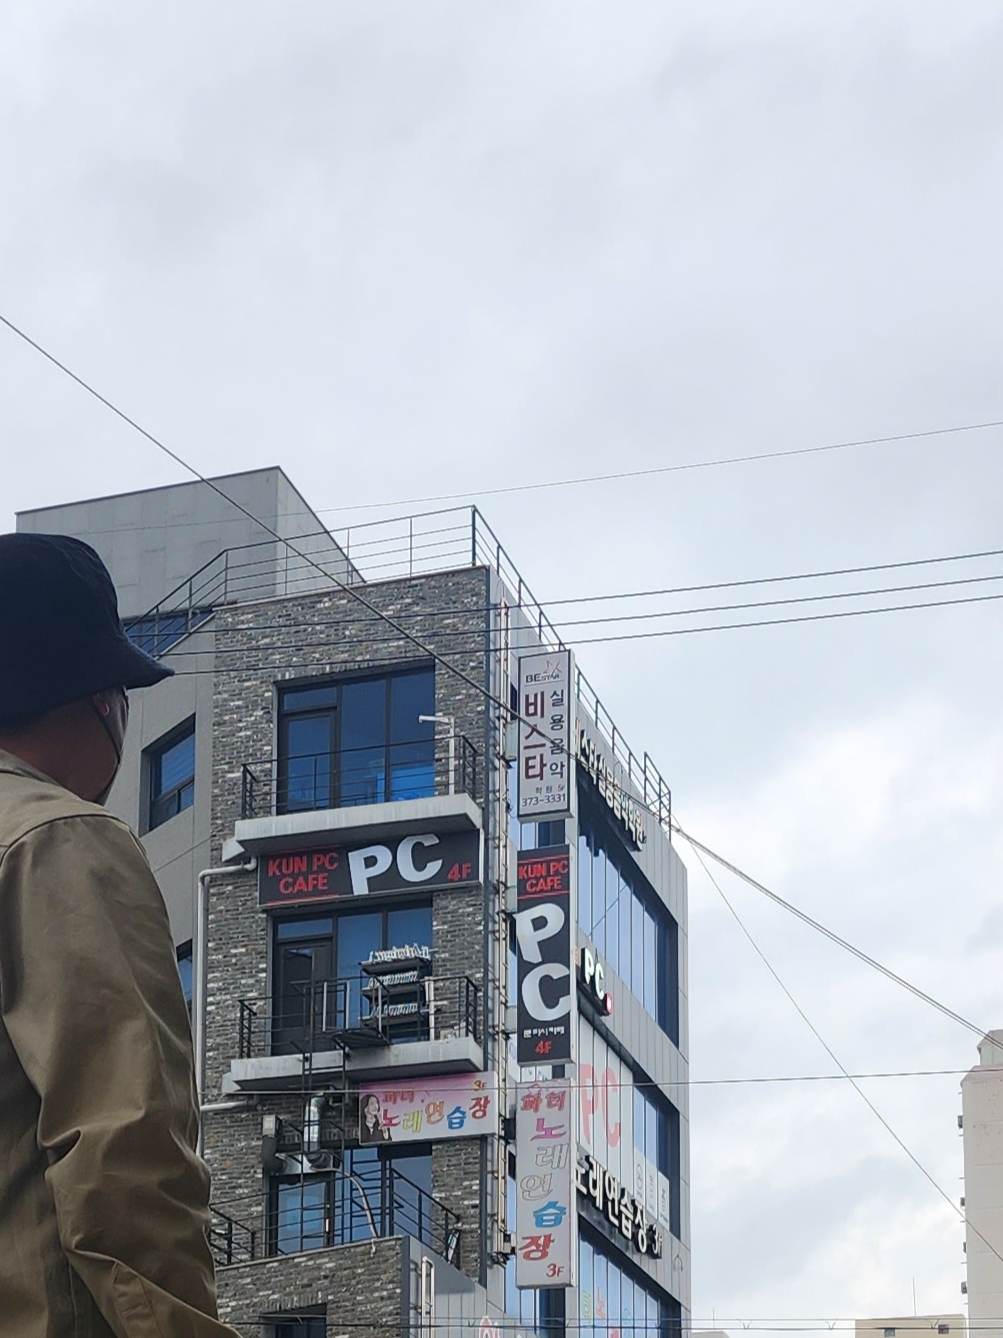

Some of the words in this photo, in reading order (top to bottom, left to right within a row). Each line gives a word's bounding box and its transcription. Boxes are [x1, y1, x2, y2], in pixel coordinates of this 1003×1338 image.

[523, 690, 547, 781] 비스타
[549, 688, 565, 779] 실용음악
[522, 793, 566, 807] 373-3331
[268, 858, 307, 877] KUN
[312, 852, 339, 871] PC
[348, 833, 443, 896] PC
[448, 862, 471, 881] 4F
[550, 861, 569, 875] PC
[279, 873, 329, 894] CAFE
[526, 876, 562, 893] CAFE
[513, 902, 570, 1021] PC
[382, 1095, 490, 1133] 노래연습장
[519, 1118, 567, 1261] 노래연습장
[546, 1263, 564, 1278] 3F
